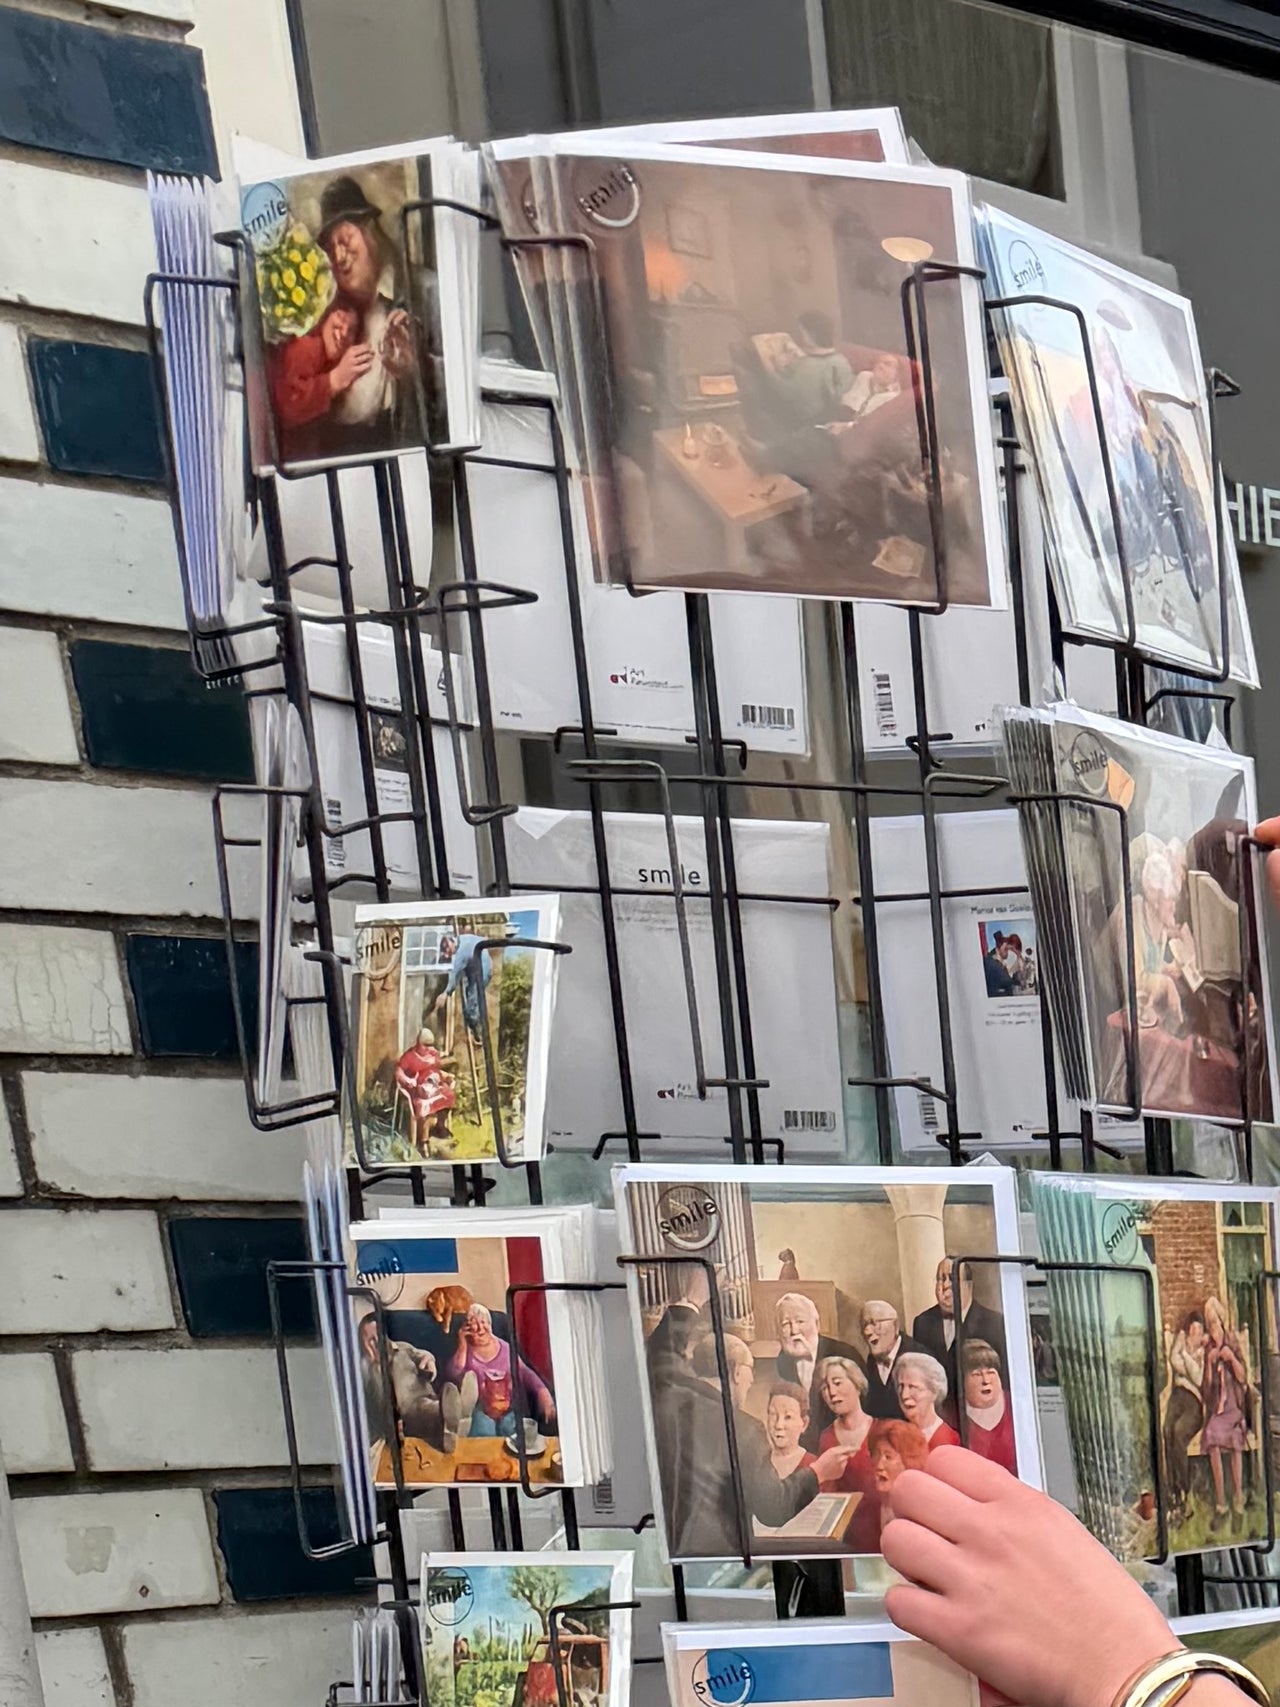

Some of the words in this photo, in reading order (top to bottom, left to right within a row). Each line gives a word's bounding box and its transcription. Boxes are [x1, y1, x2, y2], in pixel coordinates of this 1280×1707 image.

[242, 199, 288, 234] smile
[1013, 258, 1044, 289] smile
[1074, 750, 1107, 777] smile
[639, 863, 701, 885] smle
[356, 932, 401, 960] smile
[660, 1199, 717, 1235] smile
[1105, 1214, 1136, 1255] smile
[356, 1257, 403, 1287] smile
[429, 1580, 474, 1607] smile
[694, 1662, 751, 1695] smile
